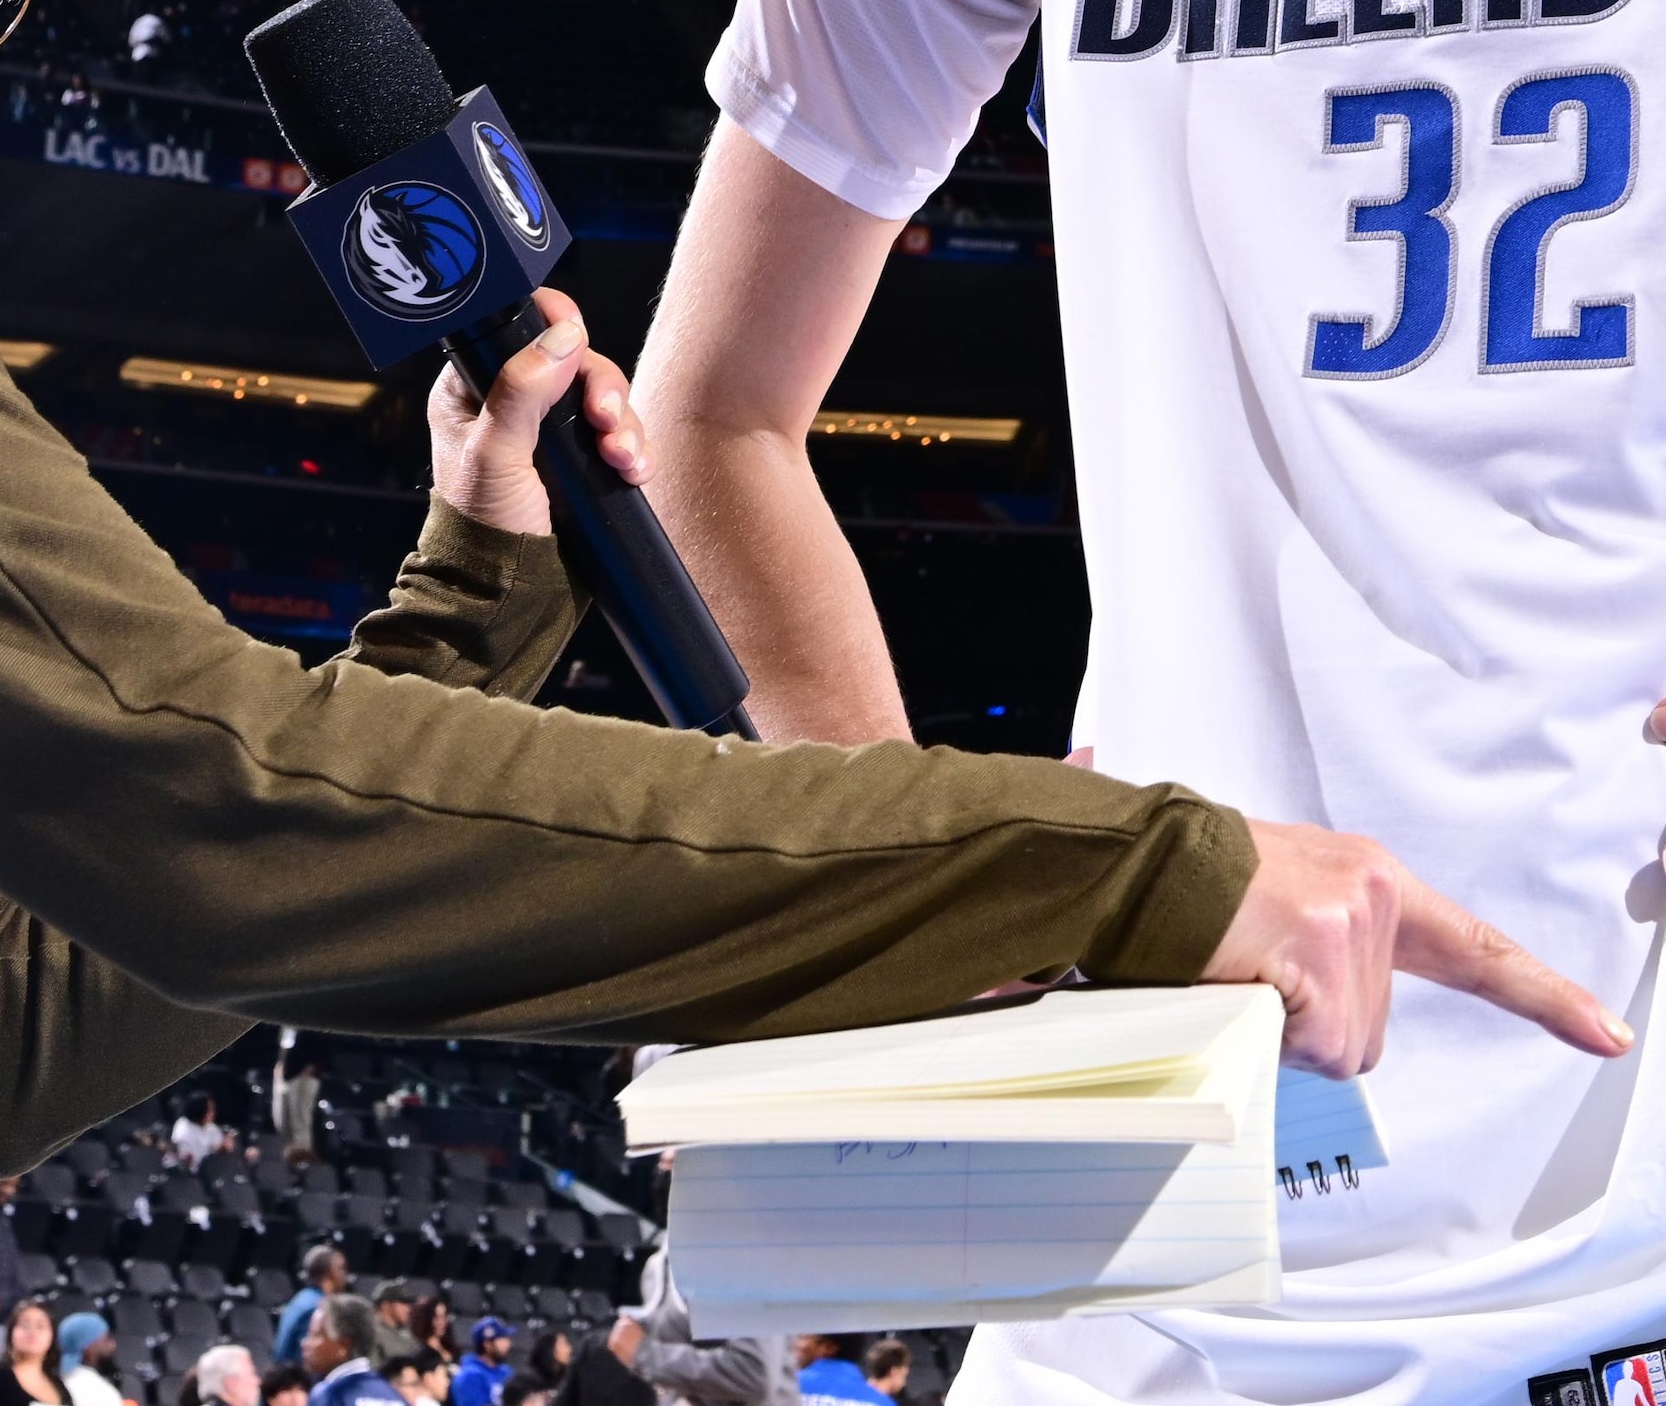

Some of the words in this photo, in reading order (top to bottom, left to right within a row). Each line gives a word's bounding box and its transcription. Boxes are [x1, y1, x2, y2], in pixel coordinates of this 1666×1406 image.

[44, 128, 107, 169] LAC
[147, 142, 211, 184] DAL
[1300, 62, 1641, 381] 32
